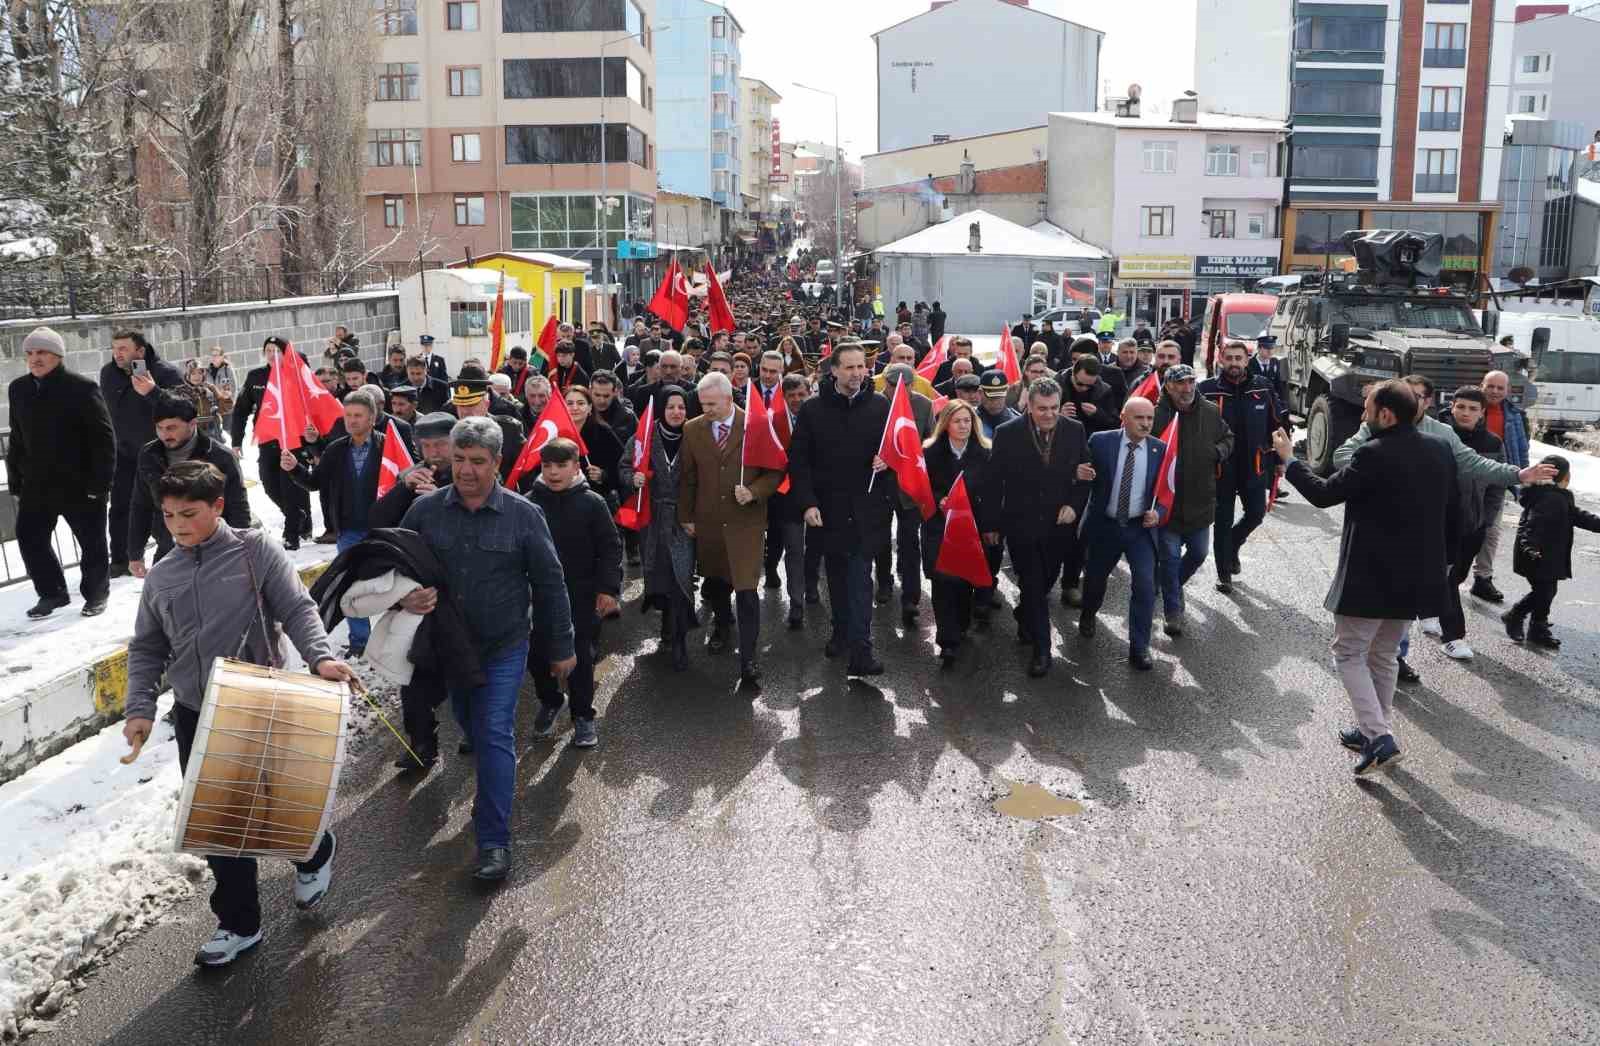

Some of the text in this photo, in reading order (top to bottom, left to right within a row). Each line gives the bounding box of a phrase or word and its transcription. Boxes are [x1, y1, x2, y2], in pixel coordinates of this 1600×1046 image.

[1235, 256, 1267, 264] MAKAS
[1200, 265, 1237, 274] KUAFÖR
[1238, 266, 1273, 274] SALONU
